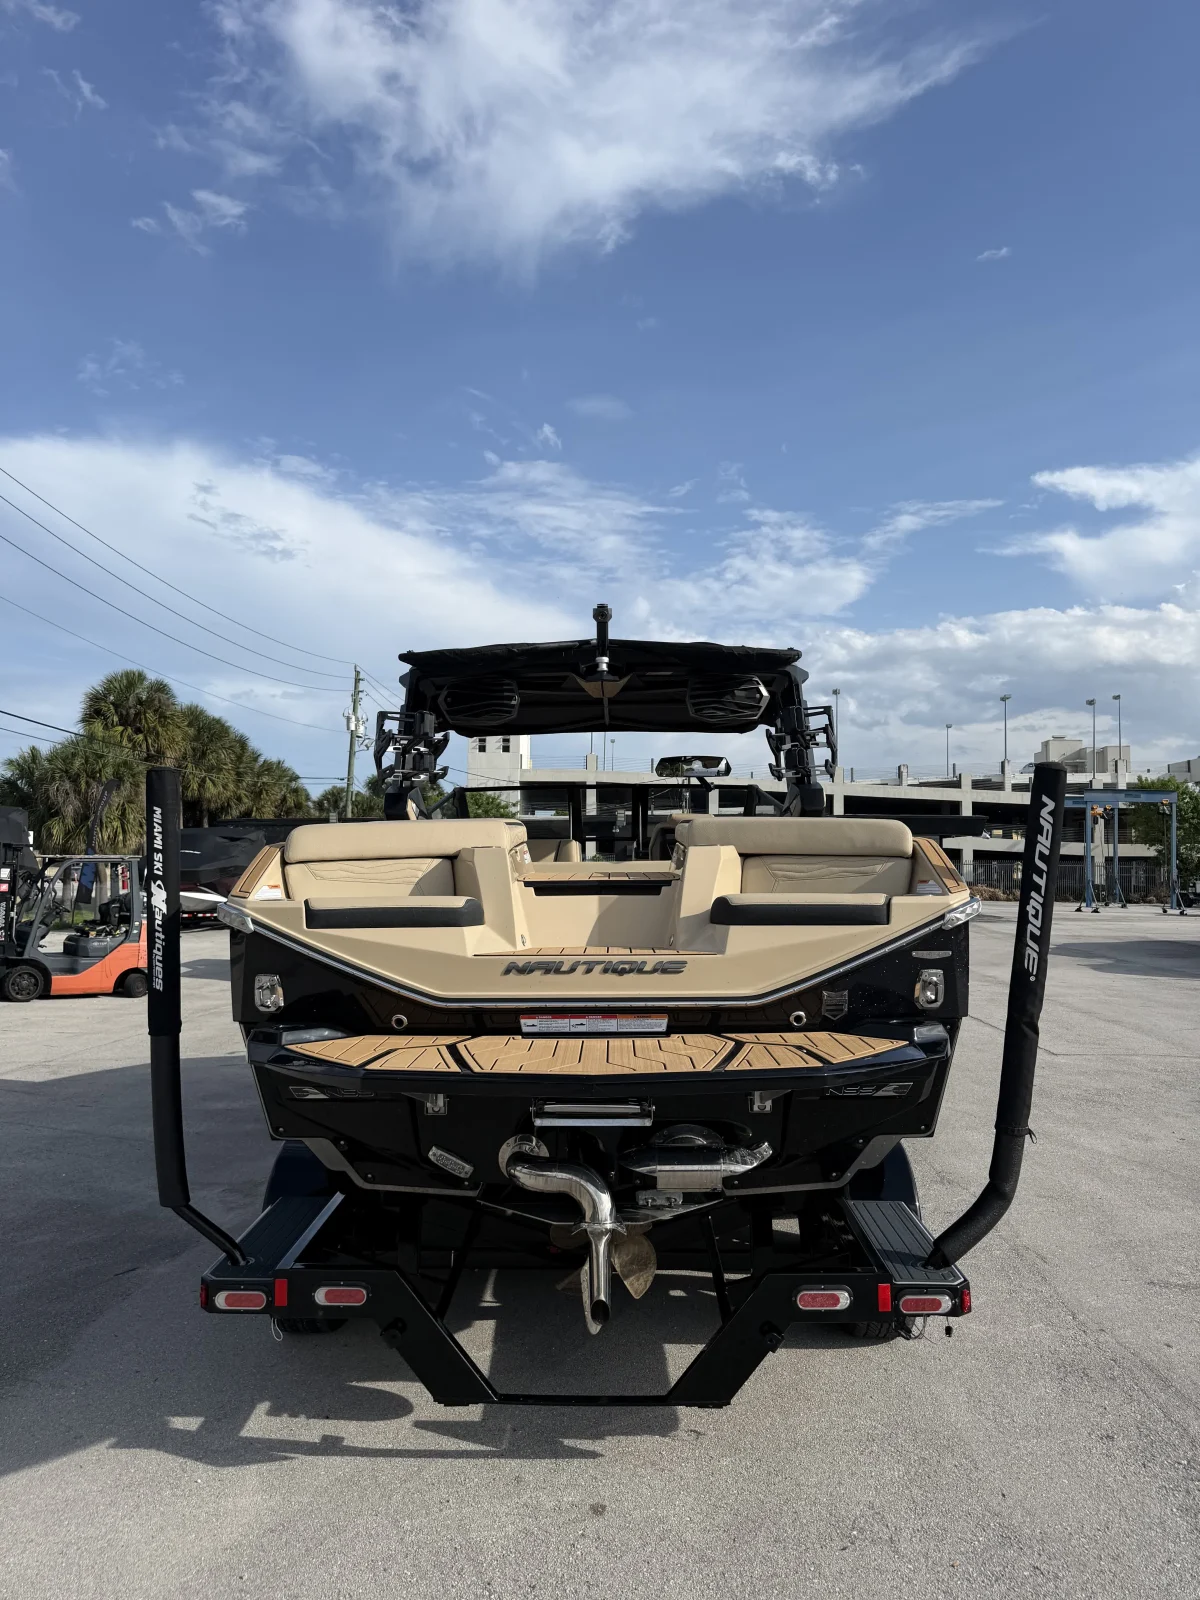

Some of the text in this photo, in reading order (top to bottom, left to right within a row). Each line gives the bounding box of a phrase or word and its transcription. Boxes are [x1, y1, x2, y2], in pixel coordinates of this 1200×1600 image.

[150, 806, 167, 992] MIAMI SKI Nautiques
[500, 960, 688, 977] NAUTIQUE
